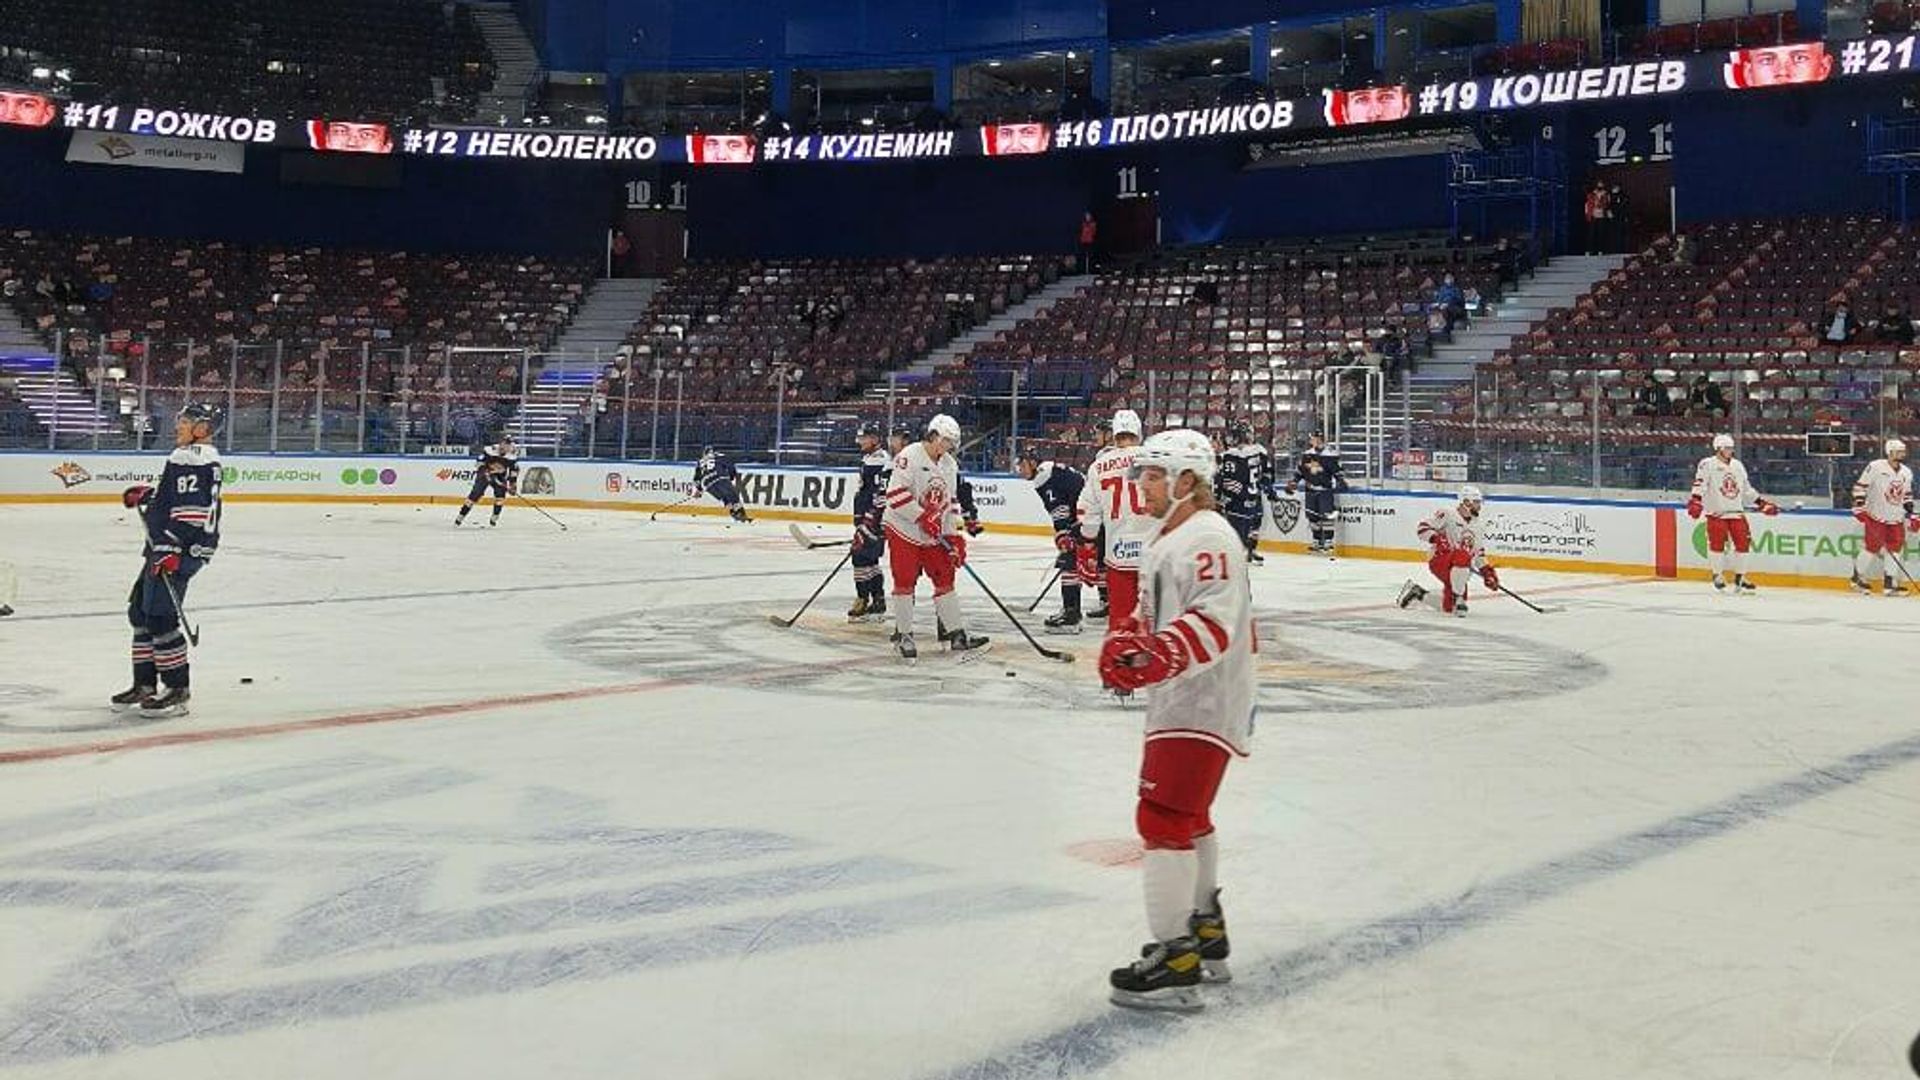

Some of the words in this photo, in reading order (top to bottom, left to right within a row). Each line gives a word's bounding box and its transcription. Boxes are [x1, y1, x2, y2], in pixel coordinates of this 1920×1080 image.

[1841, 35, 1916, 74] #21
[1419, 81, 1478, 114] #19
[1489, 60, 1686, 108] КОШЕЛЕВ
[63, 102, 119, 130] #11
[130, 108, 276, 142] РОЖКОВ
[1055, 120, 1102, 148] #16
[1109, 100, 1294, 144] ПЛОТНИКОВ
[404, 129, 458, 154] #12
[466, 132, 656, 159] НЕКОЛЕНКО
[763, 136, 811, 160] #14
[818, 131, 953, 159] КУЛЕМИН
[1594, 125, 1626, 157] 12
[625, 180, 651, 203] 10
[1118, 167, 1137, 192] 11
[176, 473, 199, 493] 82
[736, 472, 847, 509] KHL.RU
[1196, 552, 1229, 580] 21
